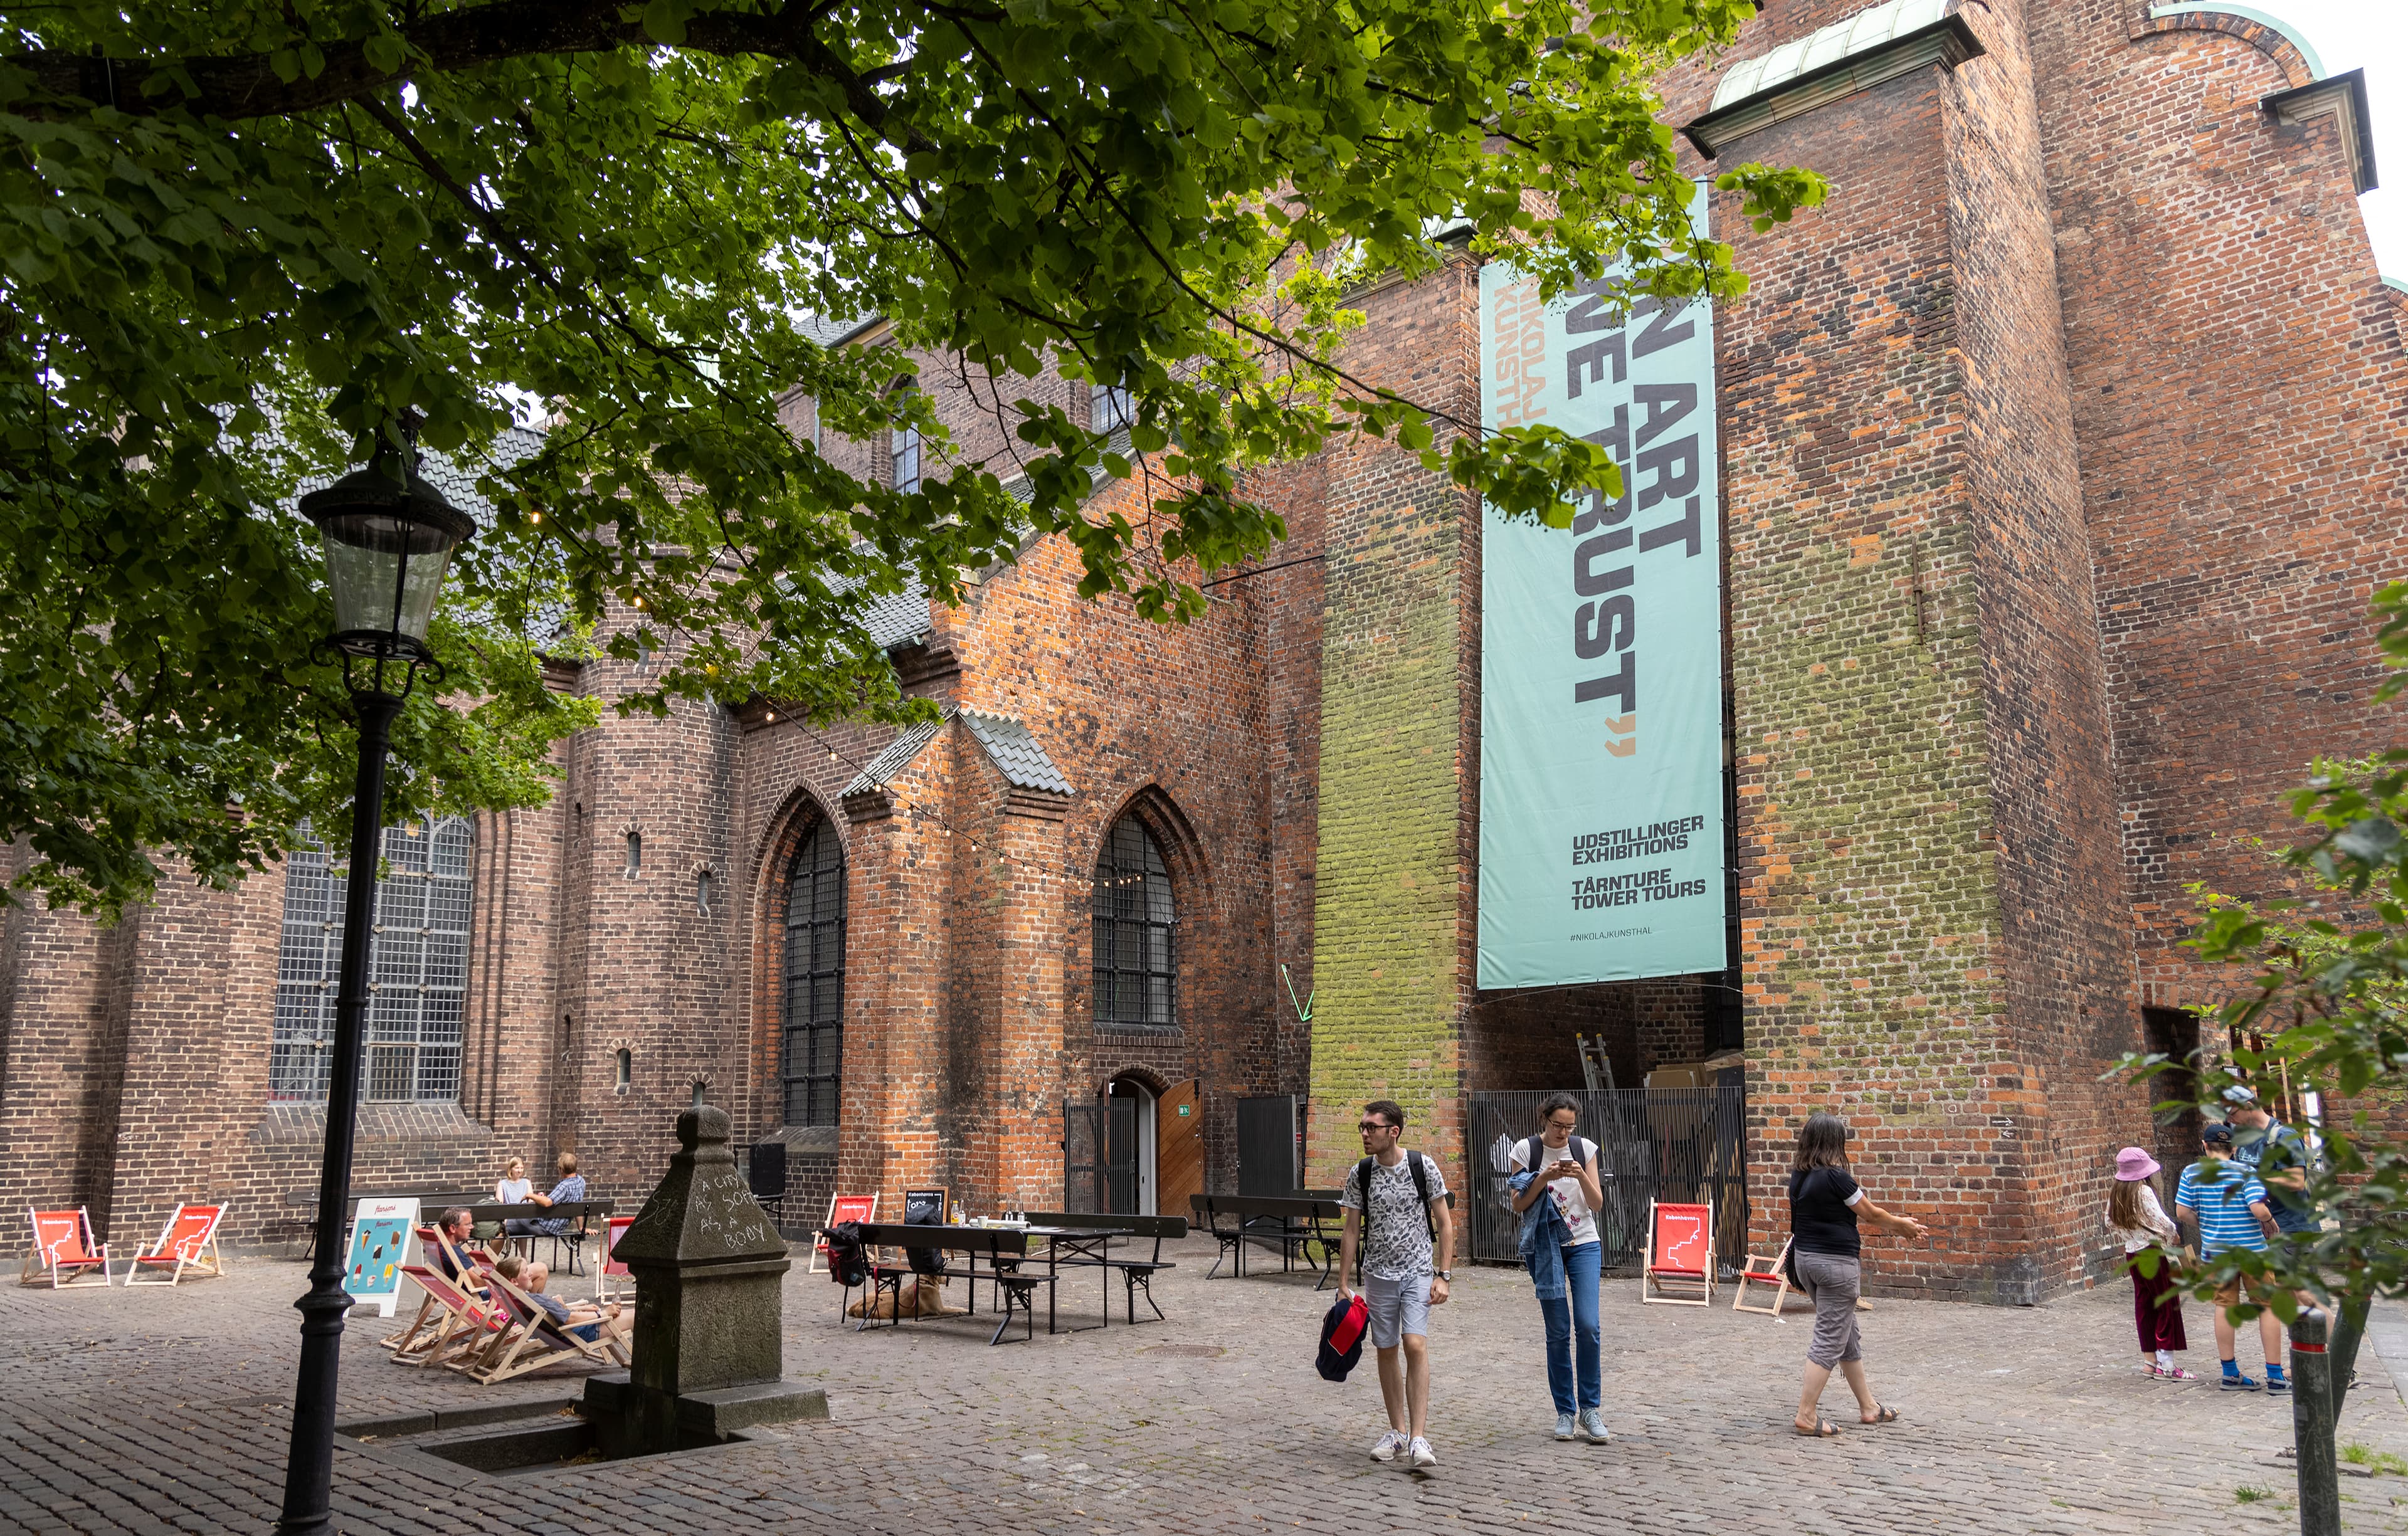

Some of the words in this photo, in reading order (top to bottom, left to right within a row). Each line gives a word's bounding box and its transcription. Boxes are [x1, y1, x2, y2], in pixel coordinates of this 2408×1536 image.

[1565, 243, 1627, 399] WE
[1519, 274, 1547, 421] NIKOLAJ
[1494, 283, 1521, 463] KUNSTH
[1634, 383, 1701, 558] ART
[1573, 815, 1704, 850] UDSTILLINGER
[1572, 834, 1688, 866] EXHIBITIONS
[1571, 868, 1671, 895] TÅRNTURE
[1571, 889, 1638, 910] TOWER
[1642, 878, 1706, 902] TOURS
[1570, 927, 1653, 942] #NIKOLAJKUNSTHAL
[702, 1181, 710, 1192] A
[714, 1172, 739, 1189] CITY
[695, 1194, 712, 1212] AS
[722, 1189, 756, 1212] SOFT
[729, 1216, 738, 1229] A
